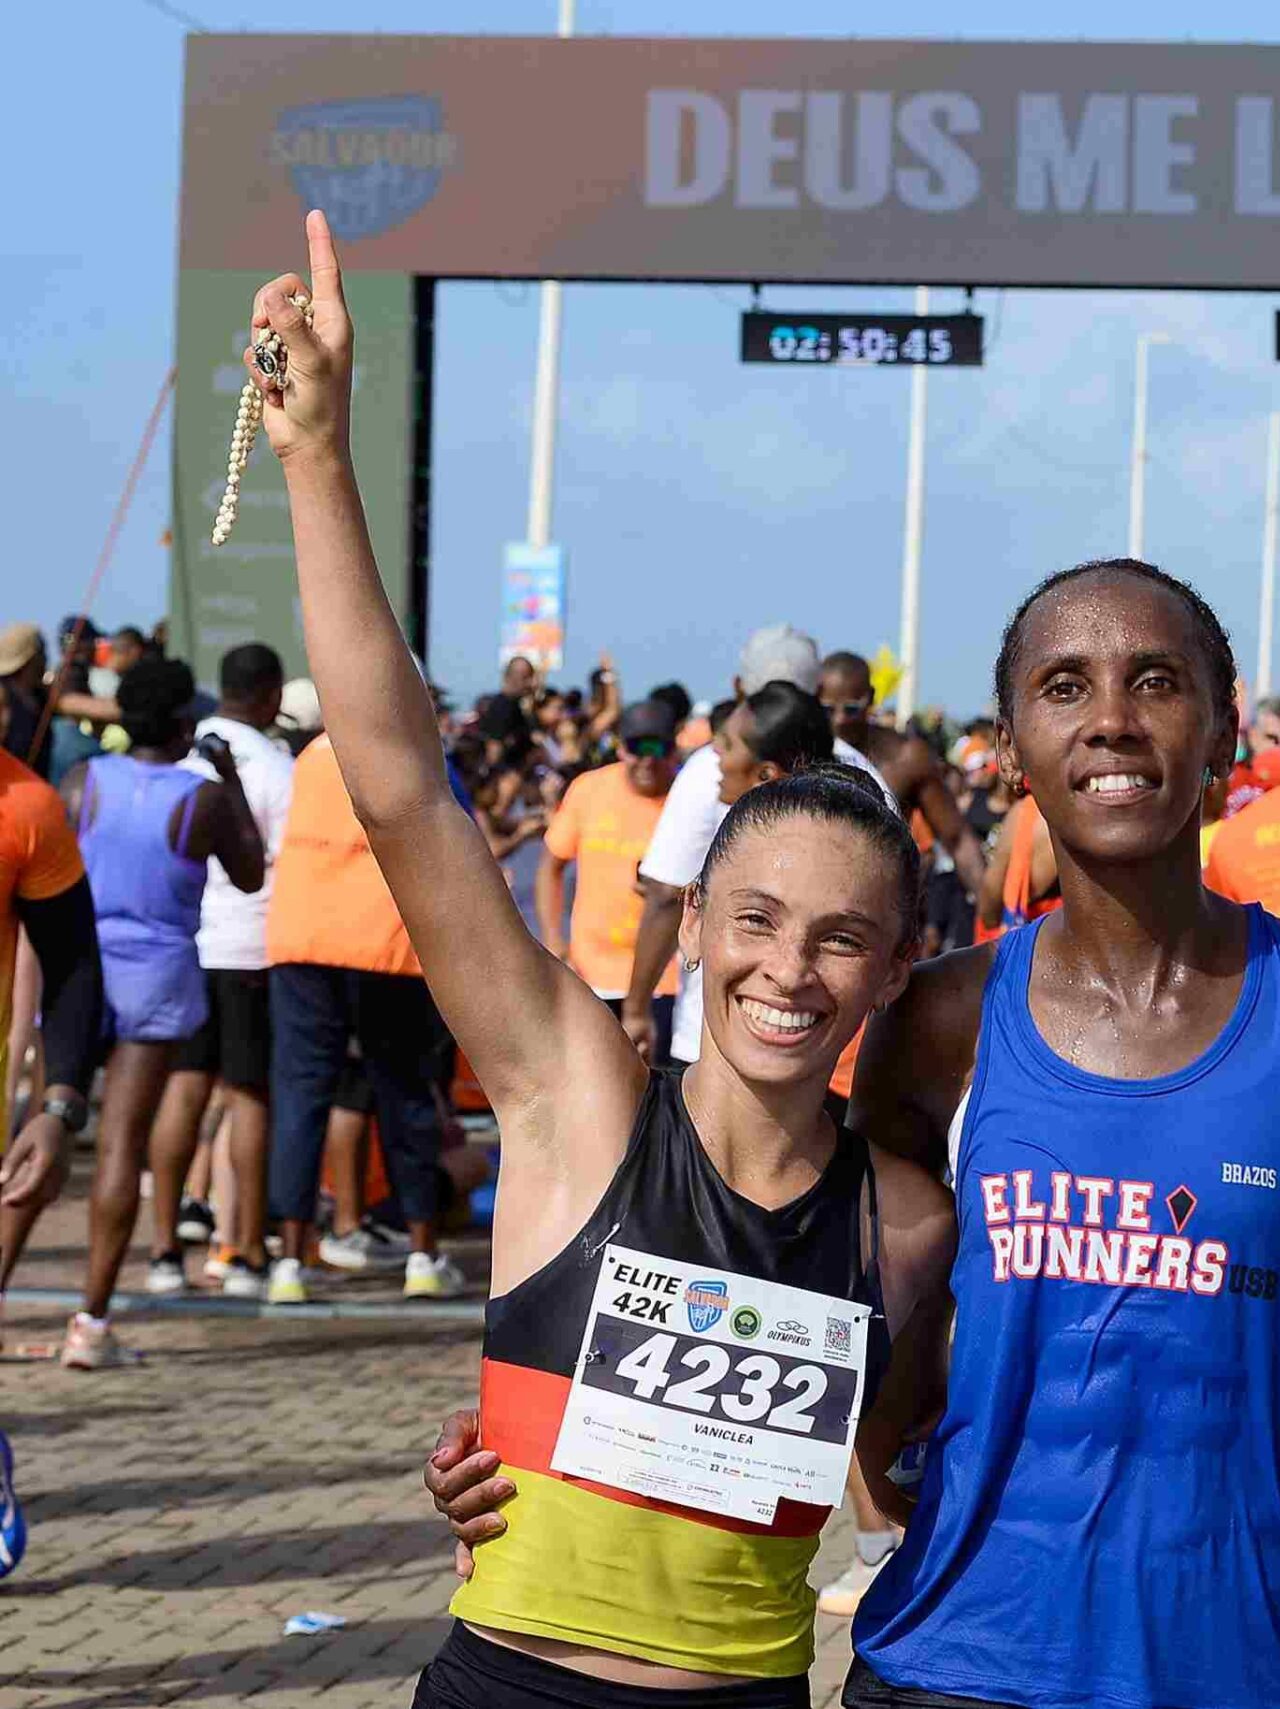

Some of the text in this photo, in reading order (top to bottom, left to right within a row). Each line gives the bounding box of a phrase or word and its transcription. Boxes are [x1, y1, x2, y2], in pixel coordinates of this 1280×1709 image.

[644, 88, 981, 213] DEUS
[1016, 92, 1198, 216] ME
[1222, 1162, 1277, 1189] BRAZOS
[980, 1168, 1155, 1232] ELITE
[987, 1224, 1229, 1297] RUNNERS
[612, 1263, 682, 1297] ELITE
[612, 1291, 674, 1324] 42K
[767, 1330, 812, 1347] OLYMPIKUS
[616, 1332, 829, 1434] 4232
[693, 1422, 754, 1446] VANICLEA
